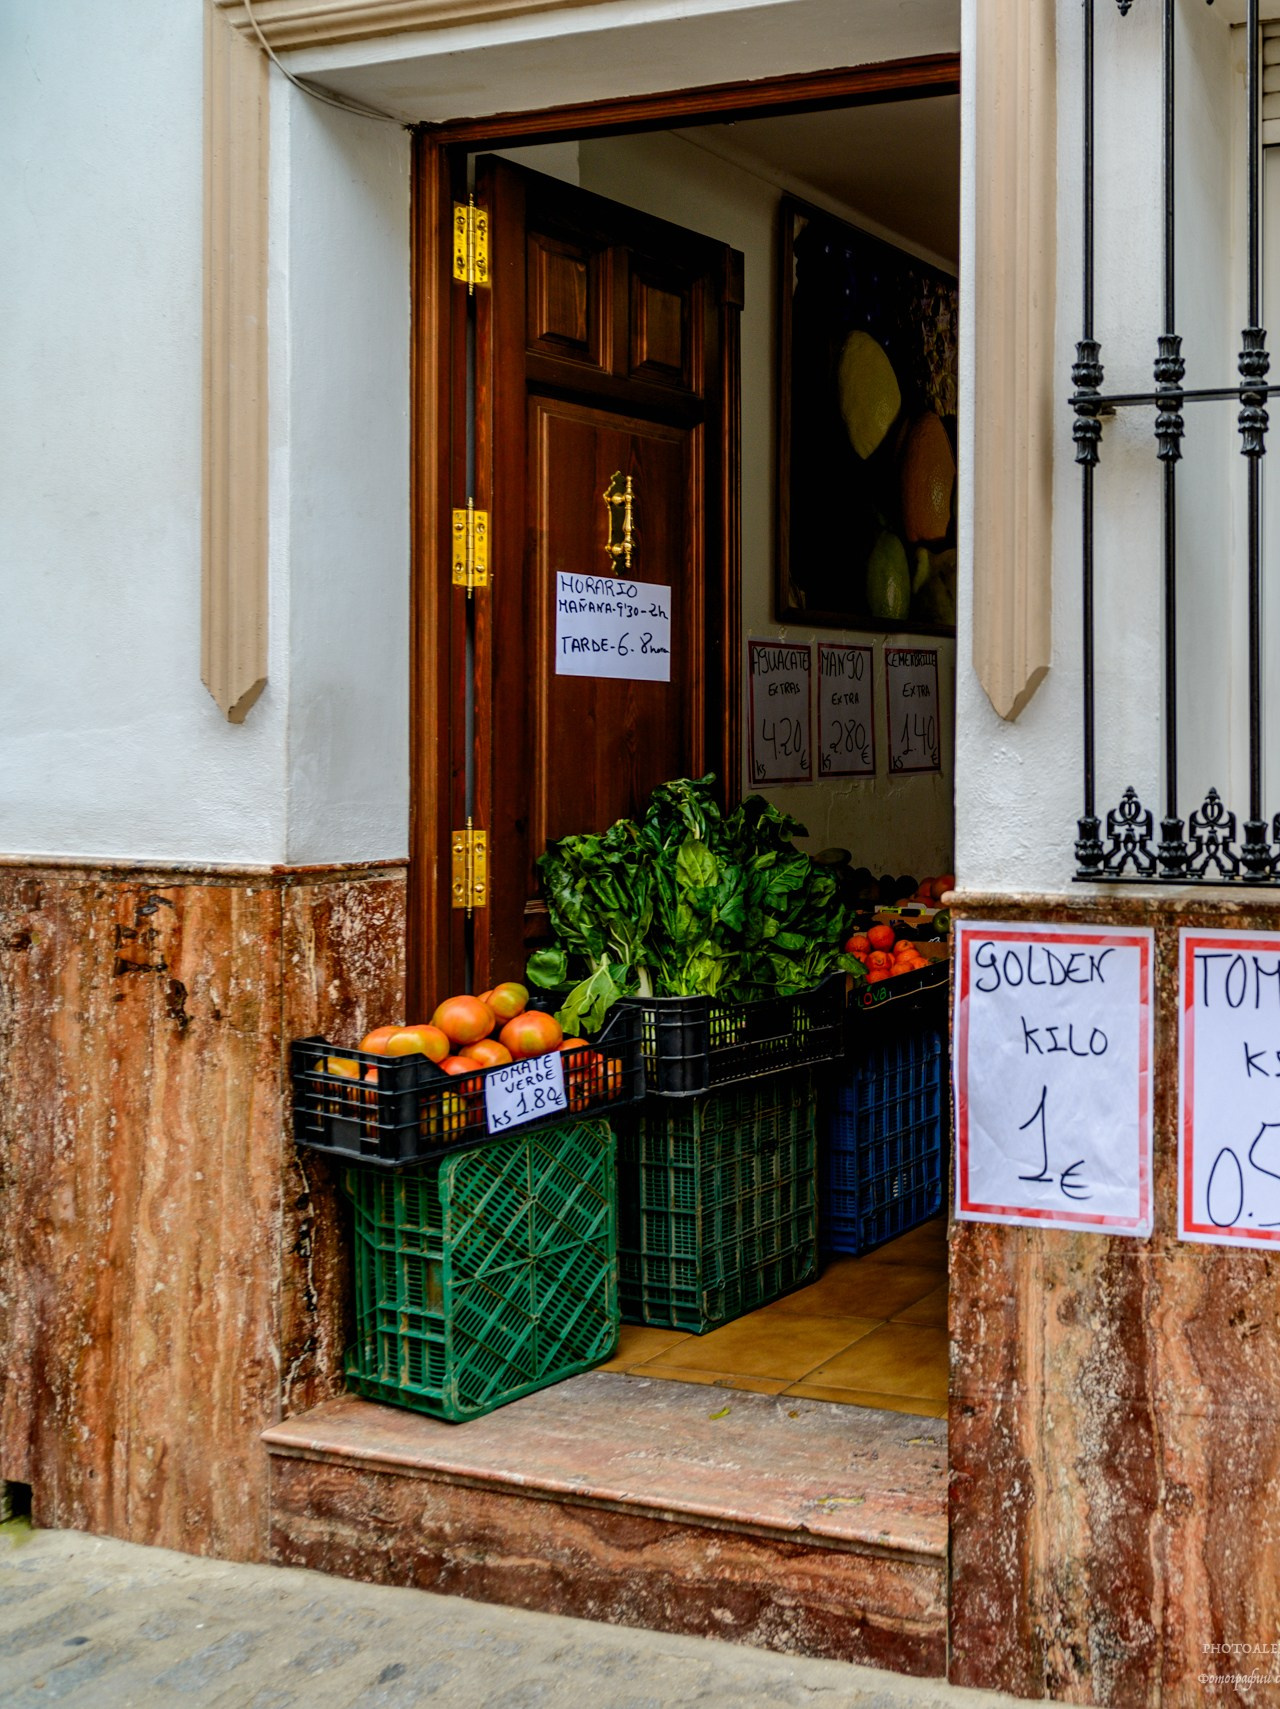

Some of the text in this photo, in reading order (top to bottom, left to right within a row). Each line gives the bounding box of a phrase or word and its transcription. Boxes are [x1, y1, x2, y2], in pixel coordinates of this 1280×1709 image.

[560, 575, 638, 598] HORARIO
[752, 646, 810, 676] AGUACATE
[821, 651, 864, 681] MANGO
[768, 682, 801, 696] EXTRAS
[832, 692, 860, 706] EXTRA
[902, 682, 931, 697] EXTRA
[975, 941, 1116, 992] GOLDEN
[1021, 1016, 1108, 1056] KILO
[488, 1055, 554, 1086] TOMATE
[505, 1069, 556, 1093] VERDE
